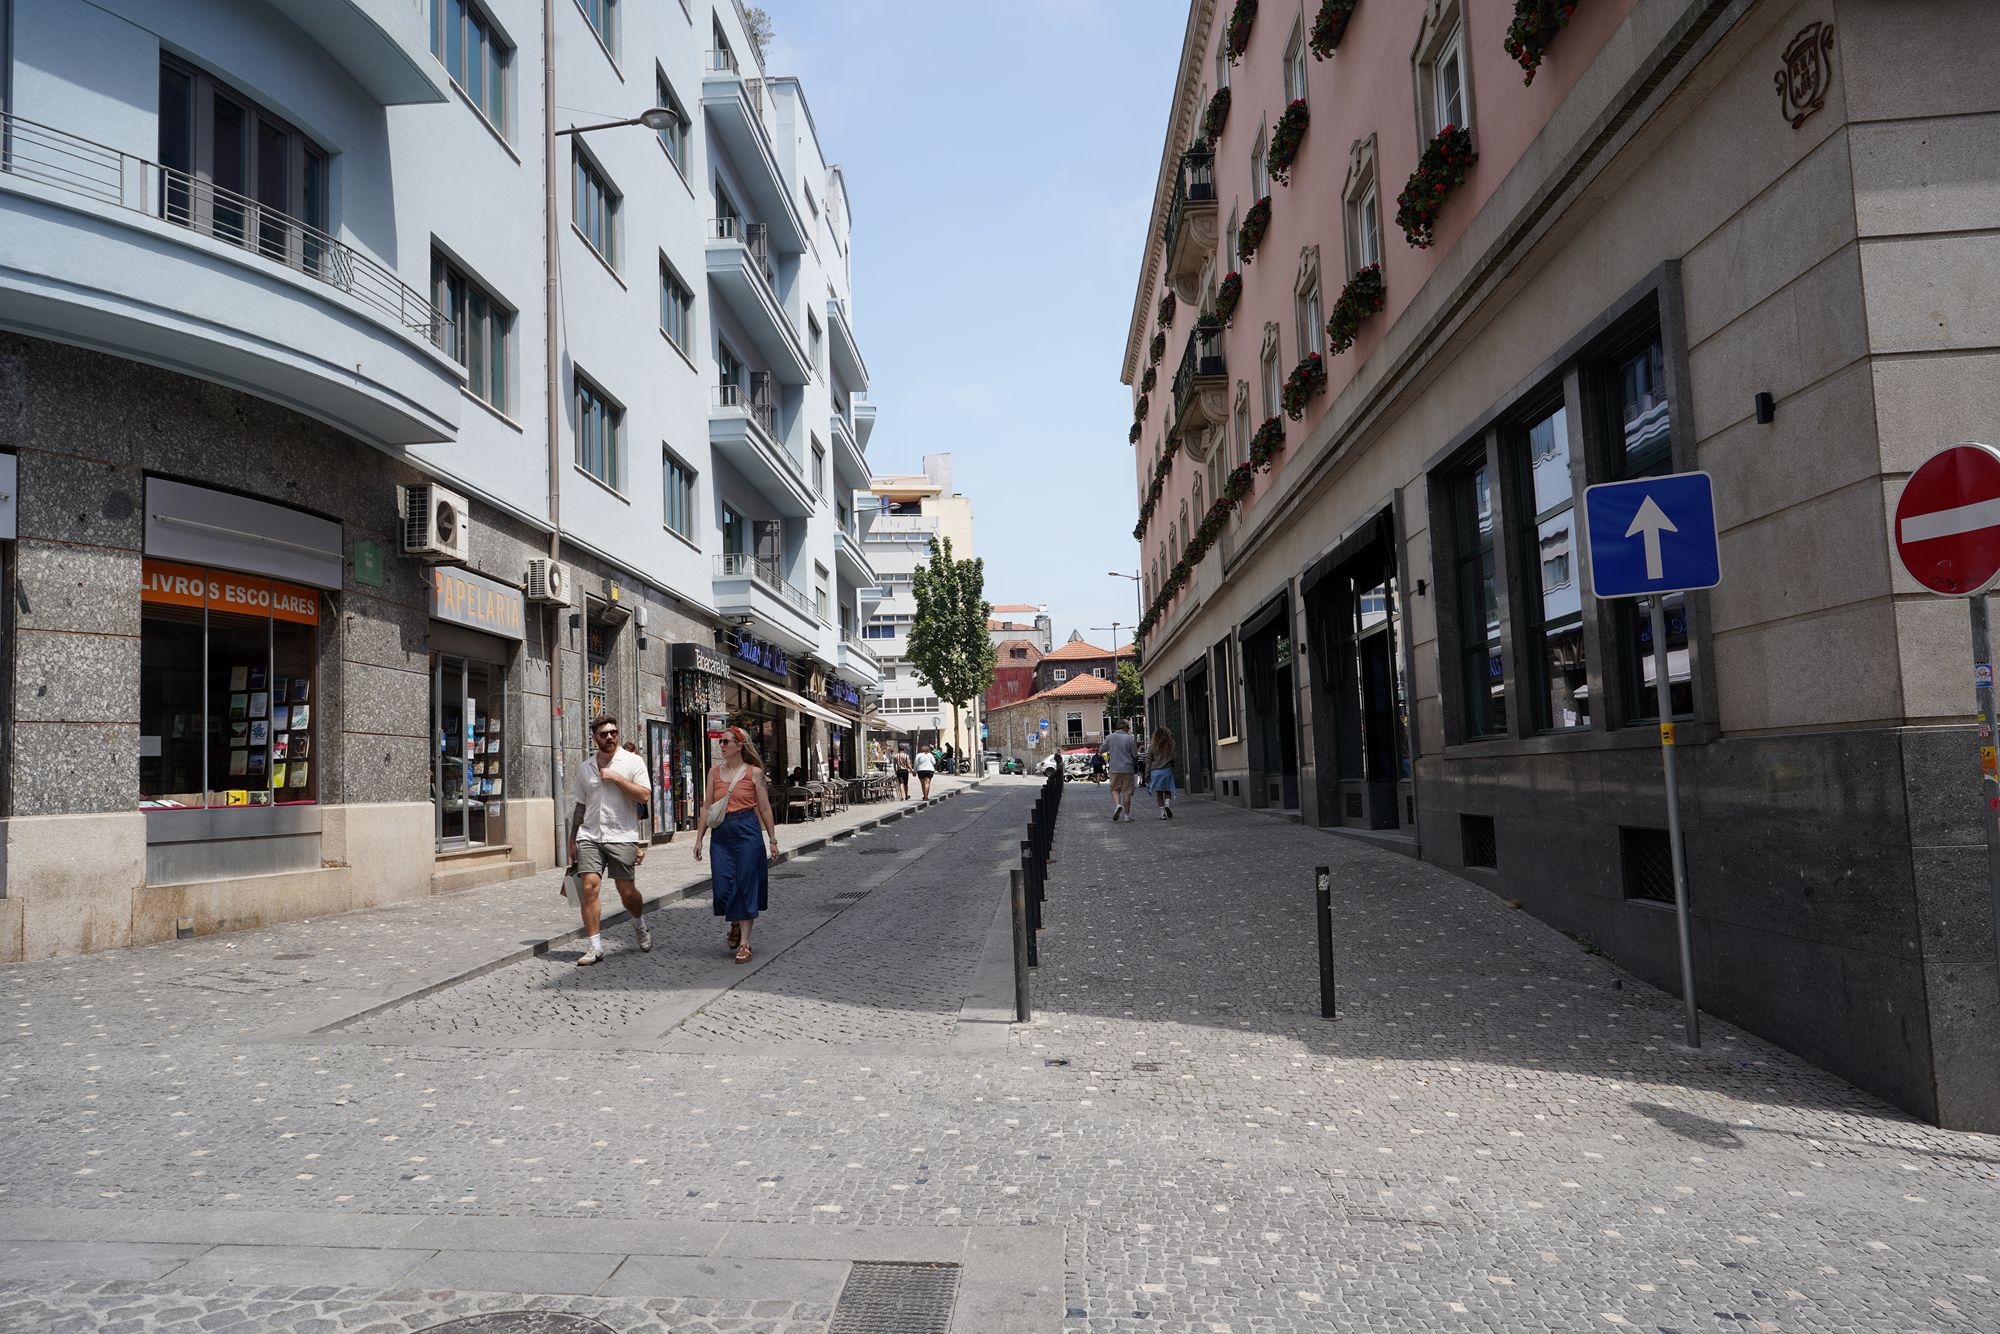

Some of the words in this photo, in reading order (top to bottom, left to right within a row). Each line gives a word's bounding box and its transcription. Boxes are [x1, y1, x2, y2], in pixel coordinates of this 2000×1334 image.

[225, 584, 315, 616] ESCOLARES
[434, 570, 520, 628] PAPELARIA
[695, 648, 720, 676] Tabacaria
